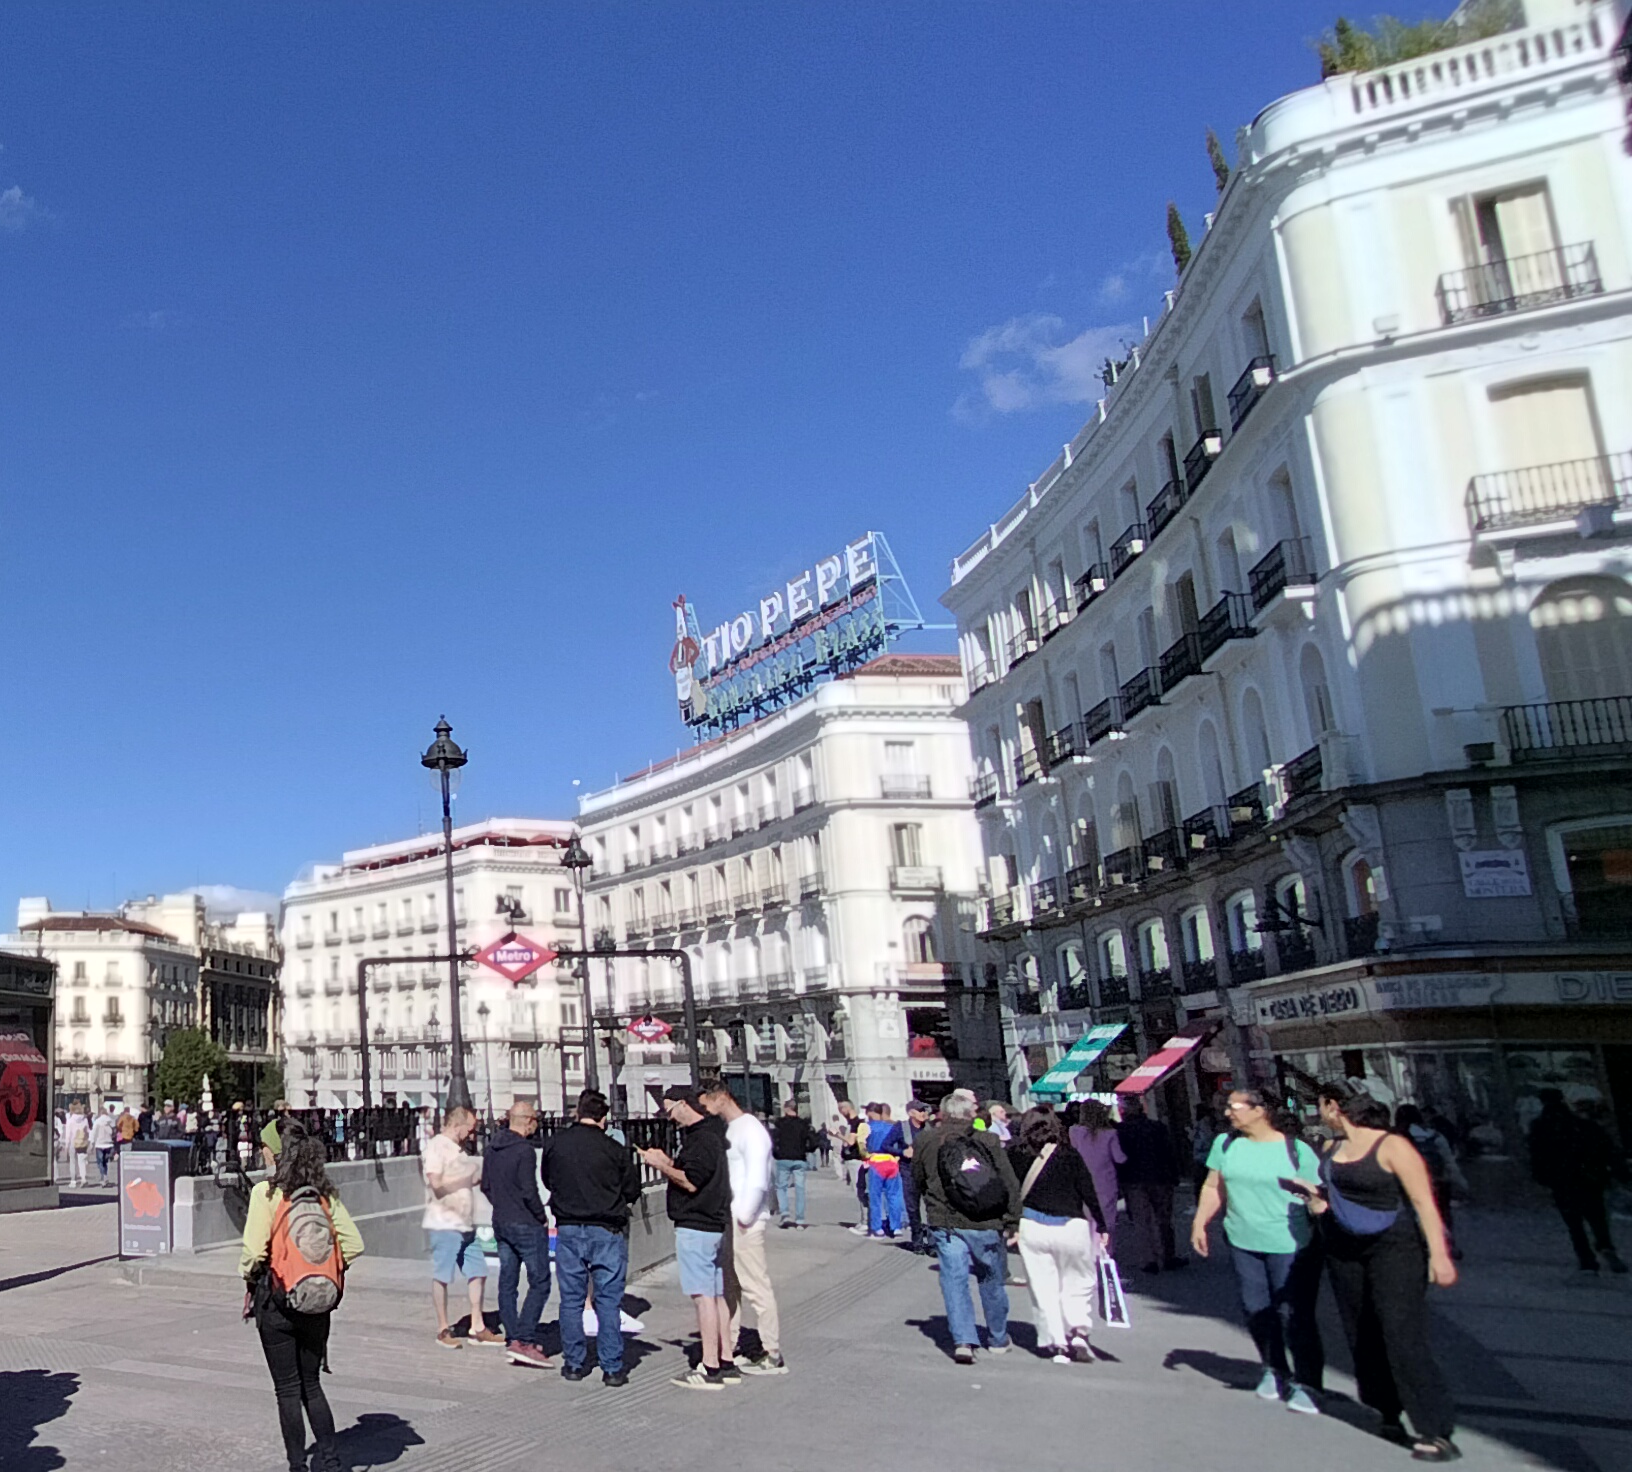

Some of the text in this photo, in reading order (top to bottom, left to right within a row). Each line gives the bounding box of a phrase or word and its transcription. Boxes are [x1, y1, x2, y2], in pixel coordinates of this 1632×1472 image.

[700, 612, 753, 670] TIO
[760, 531, 876, 638] PEPE
[495, 950, 532, 962] Metro
[505, 990, 525, 1000] Sol
